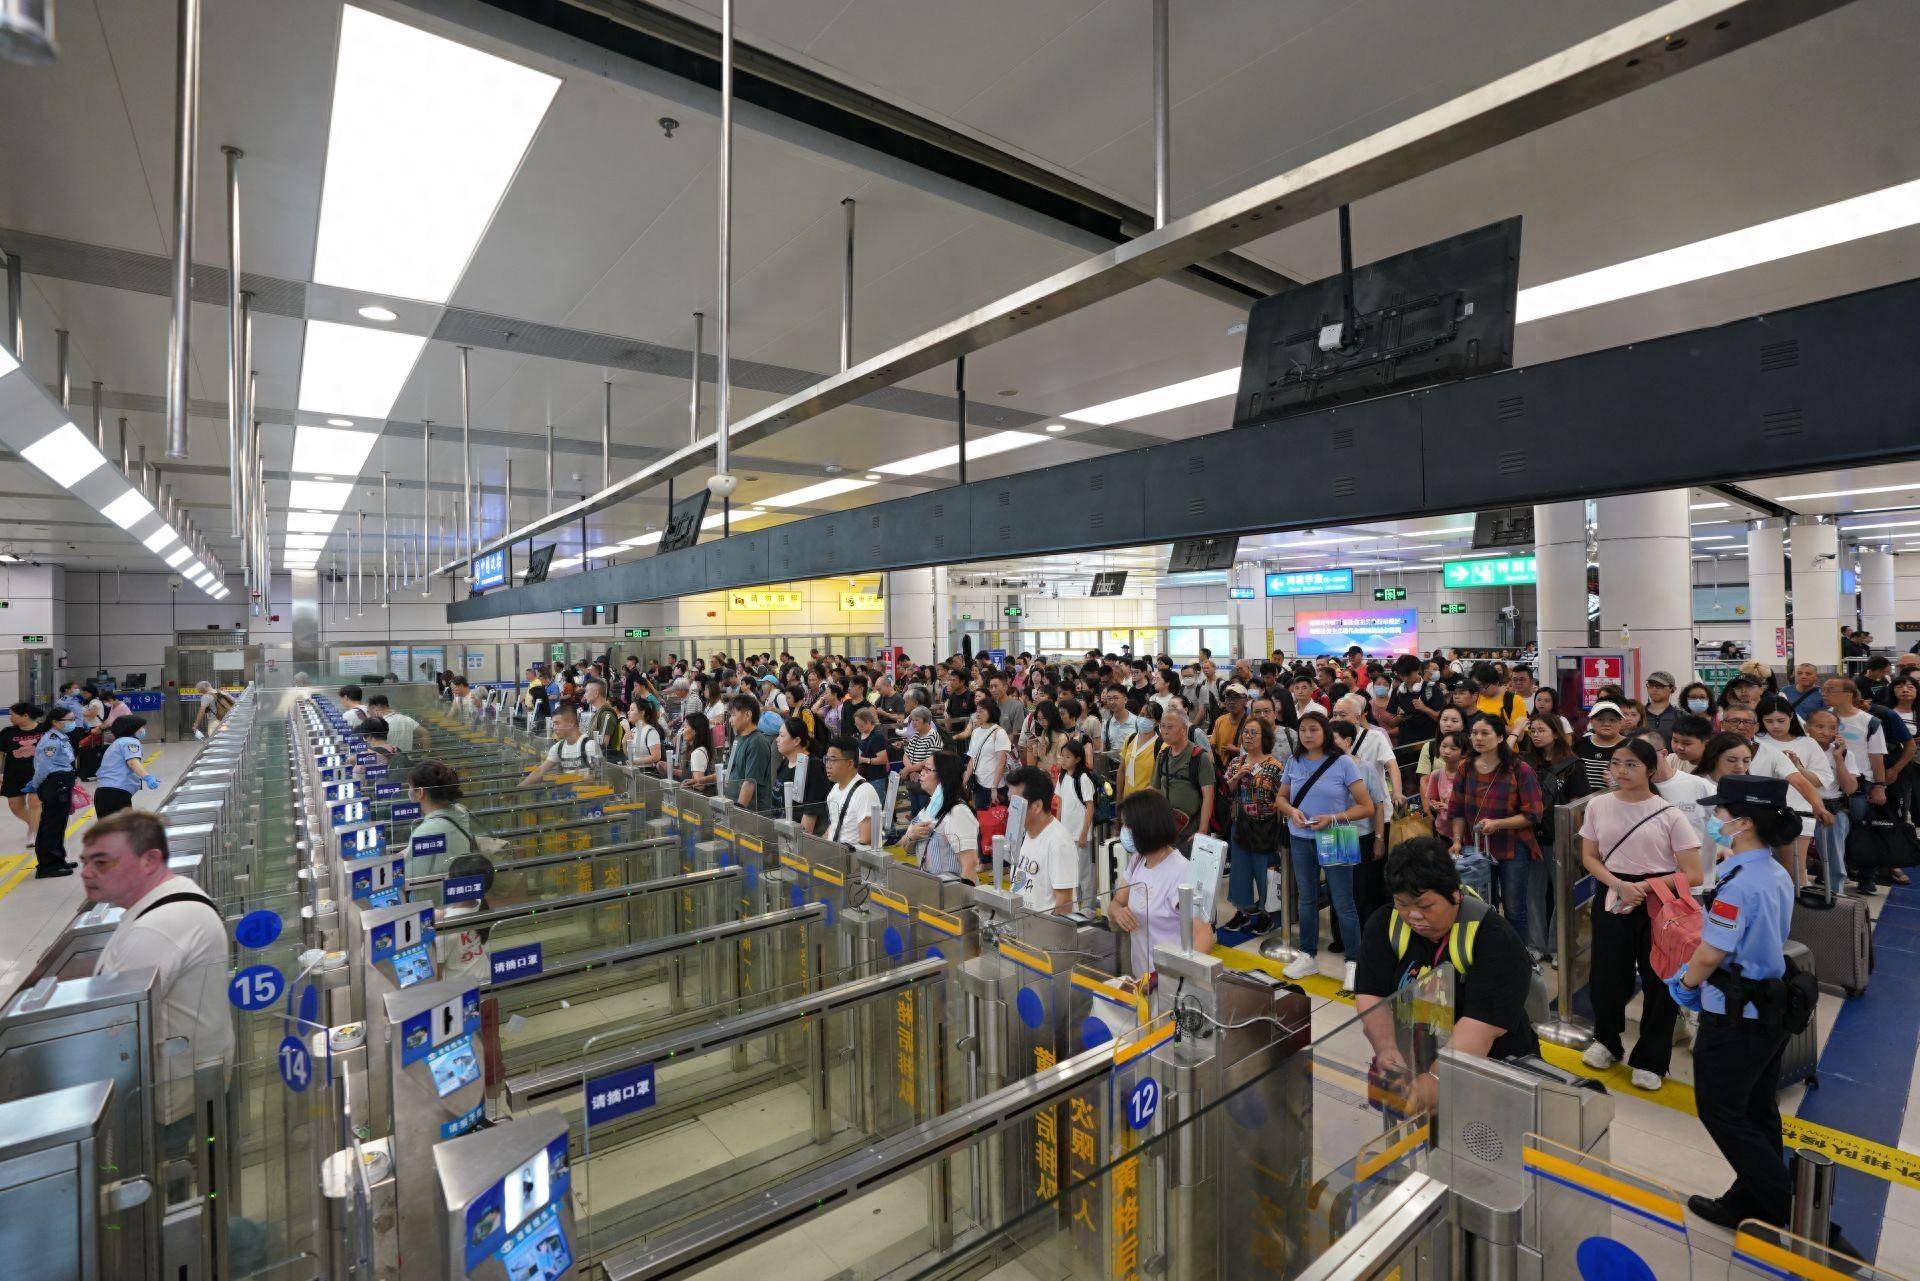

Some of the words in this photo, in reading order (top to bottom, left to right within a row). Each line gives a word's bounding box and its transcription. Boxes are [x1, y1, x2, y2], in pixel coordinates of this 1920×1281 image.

[447, 883, 482, 896] 请摘口罩
[494, 954, 538, 974] 请摘口罩
[235, 971, 276, 1005] 15
[282, 1045, 307, 1085] 14
[592, 1079, 650, 1110] 请摘口罩
[1132, 1084, 1154, 1123] 12
